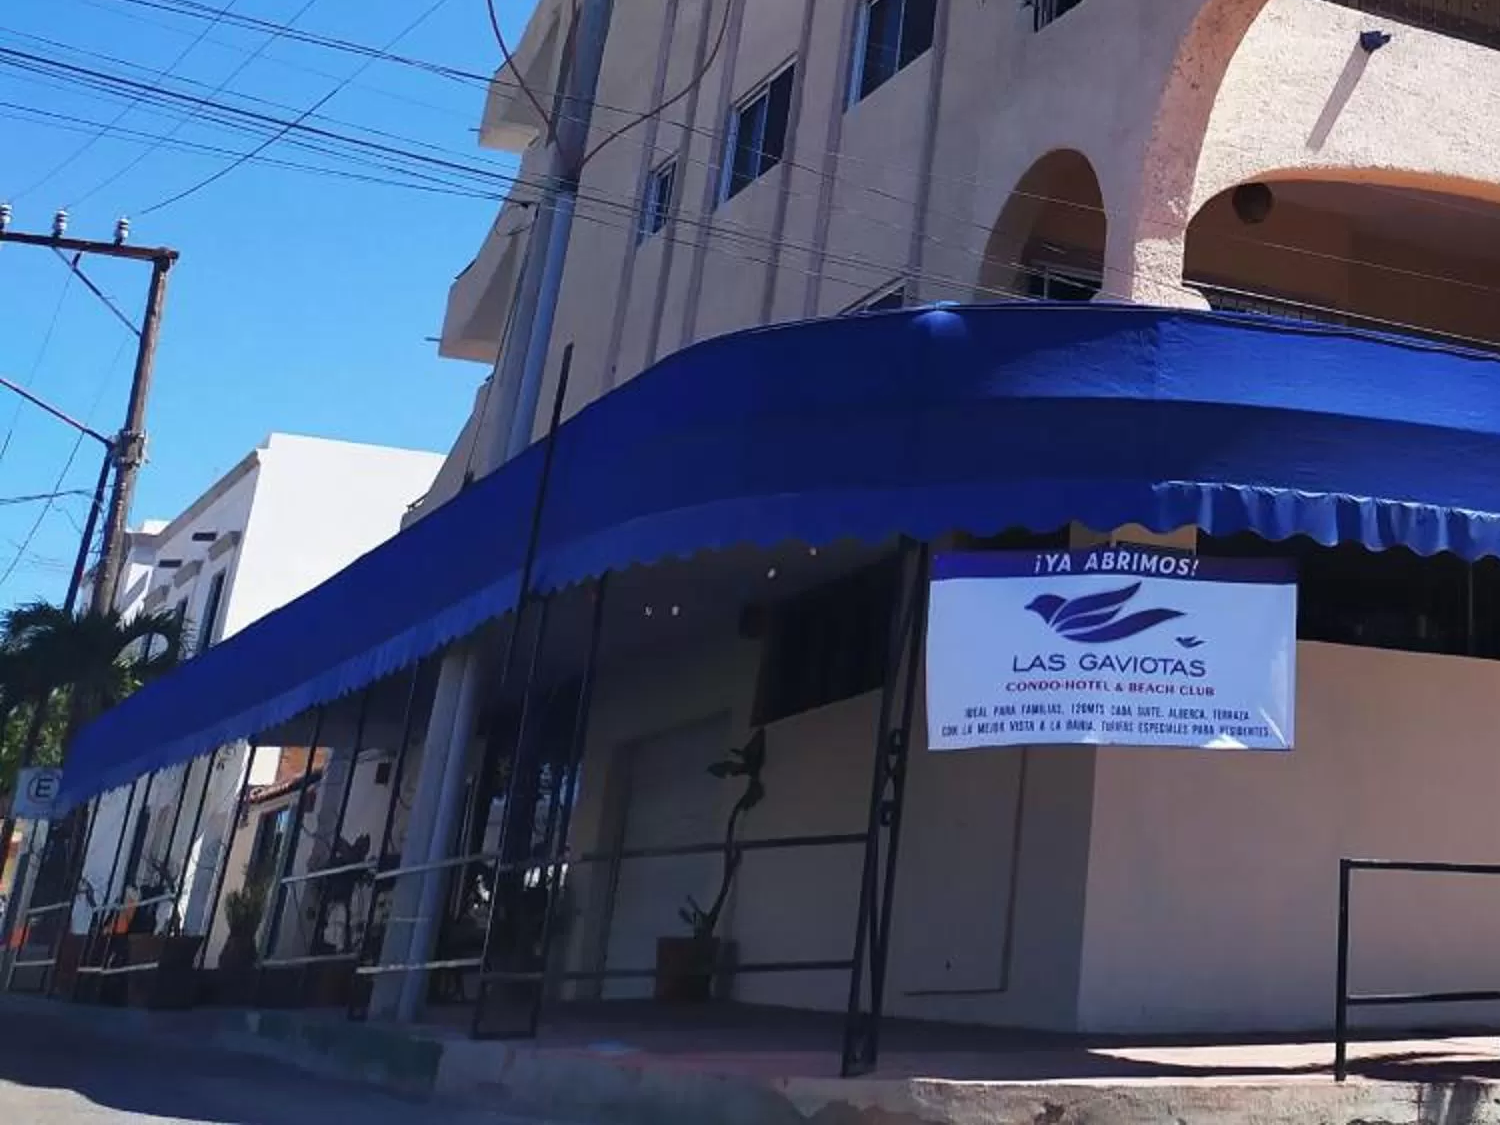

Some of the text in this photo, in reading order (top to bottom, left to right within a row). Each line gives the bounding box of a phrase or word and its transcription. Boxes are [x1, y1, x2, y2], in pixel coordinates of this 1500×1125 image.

[1034, 551, 1200, 577] ¡YA ABRIMOS!
[1012, 653, 1207, 678] LAS GAVIOTAS
[1114, 680, 1124, 692] &
[1128, 682, 1175, 695] BEACH
[1179, 684, 1216, 697] CLUB
[965, 707, 988, 718] IDEAL
[993, 705, 1016, 716] PARA
[1111, 705, 1132, 716] CADA
[1213, 708, 1250, 721] TERRAZA
[941, 725, 958, 737] CON
[961, 724, 972, 735] LA
[977, 721, 1005, 734] MEJOR
[1009, 720, 1035, 732] VISTA
[1039, 720, 1046, 731] A
[1050, 720, 1061, 732] LA
[1138, 722, 1188, 735] ESPECIALES
[1192, 724, 1215, 736] PARA
[35, 778, 53, 798] E
